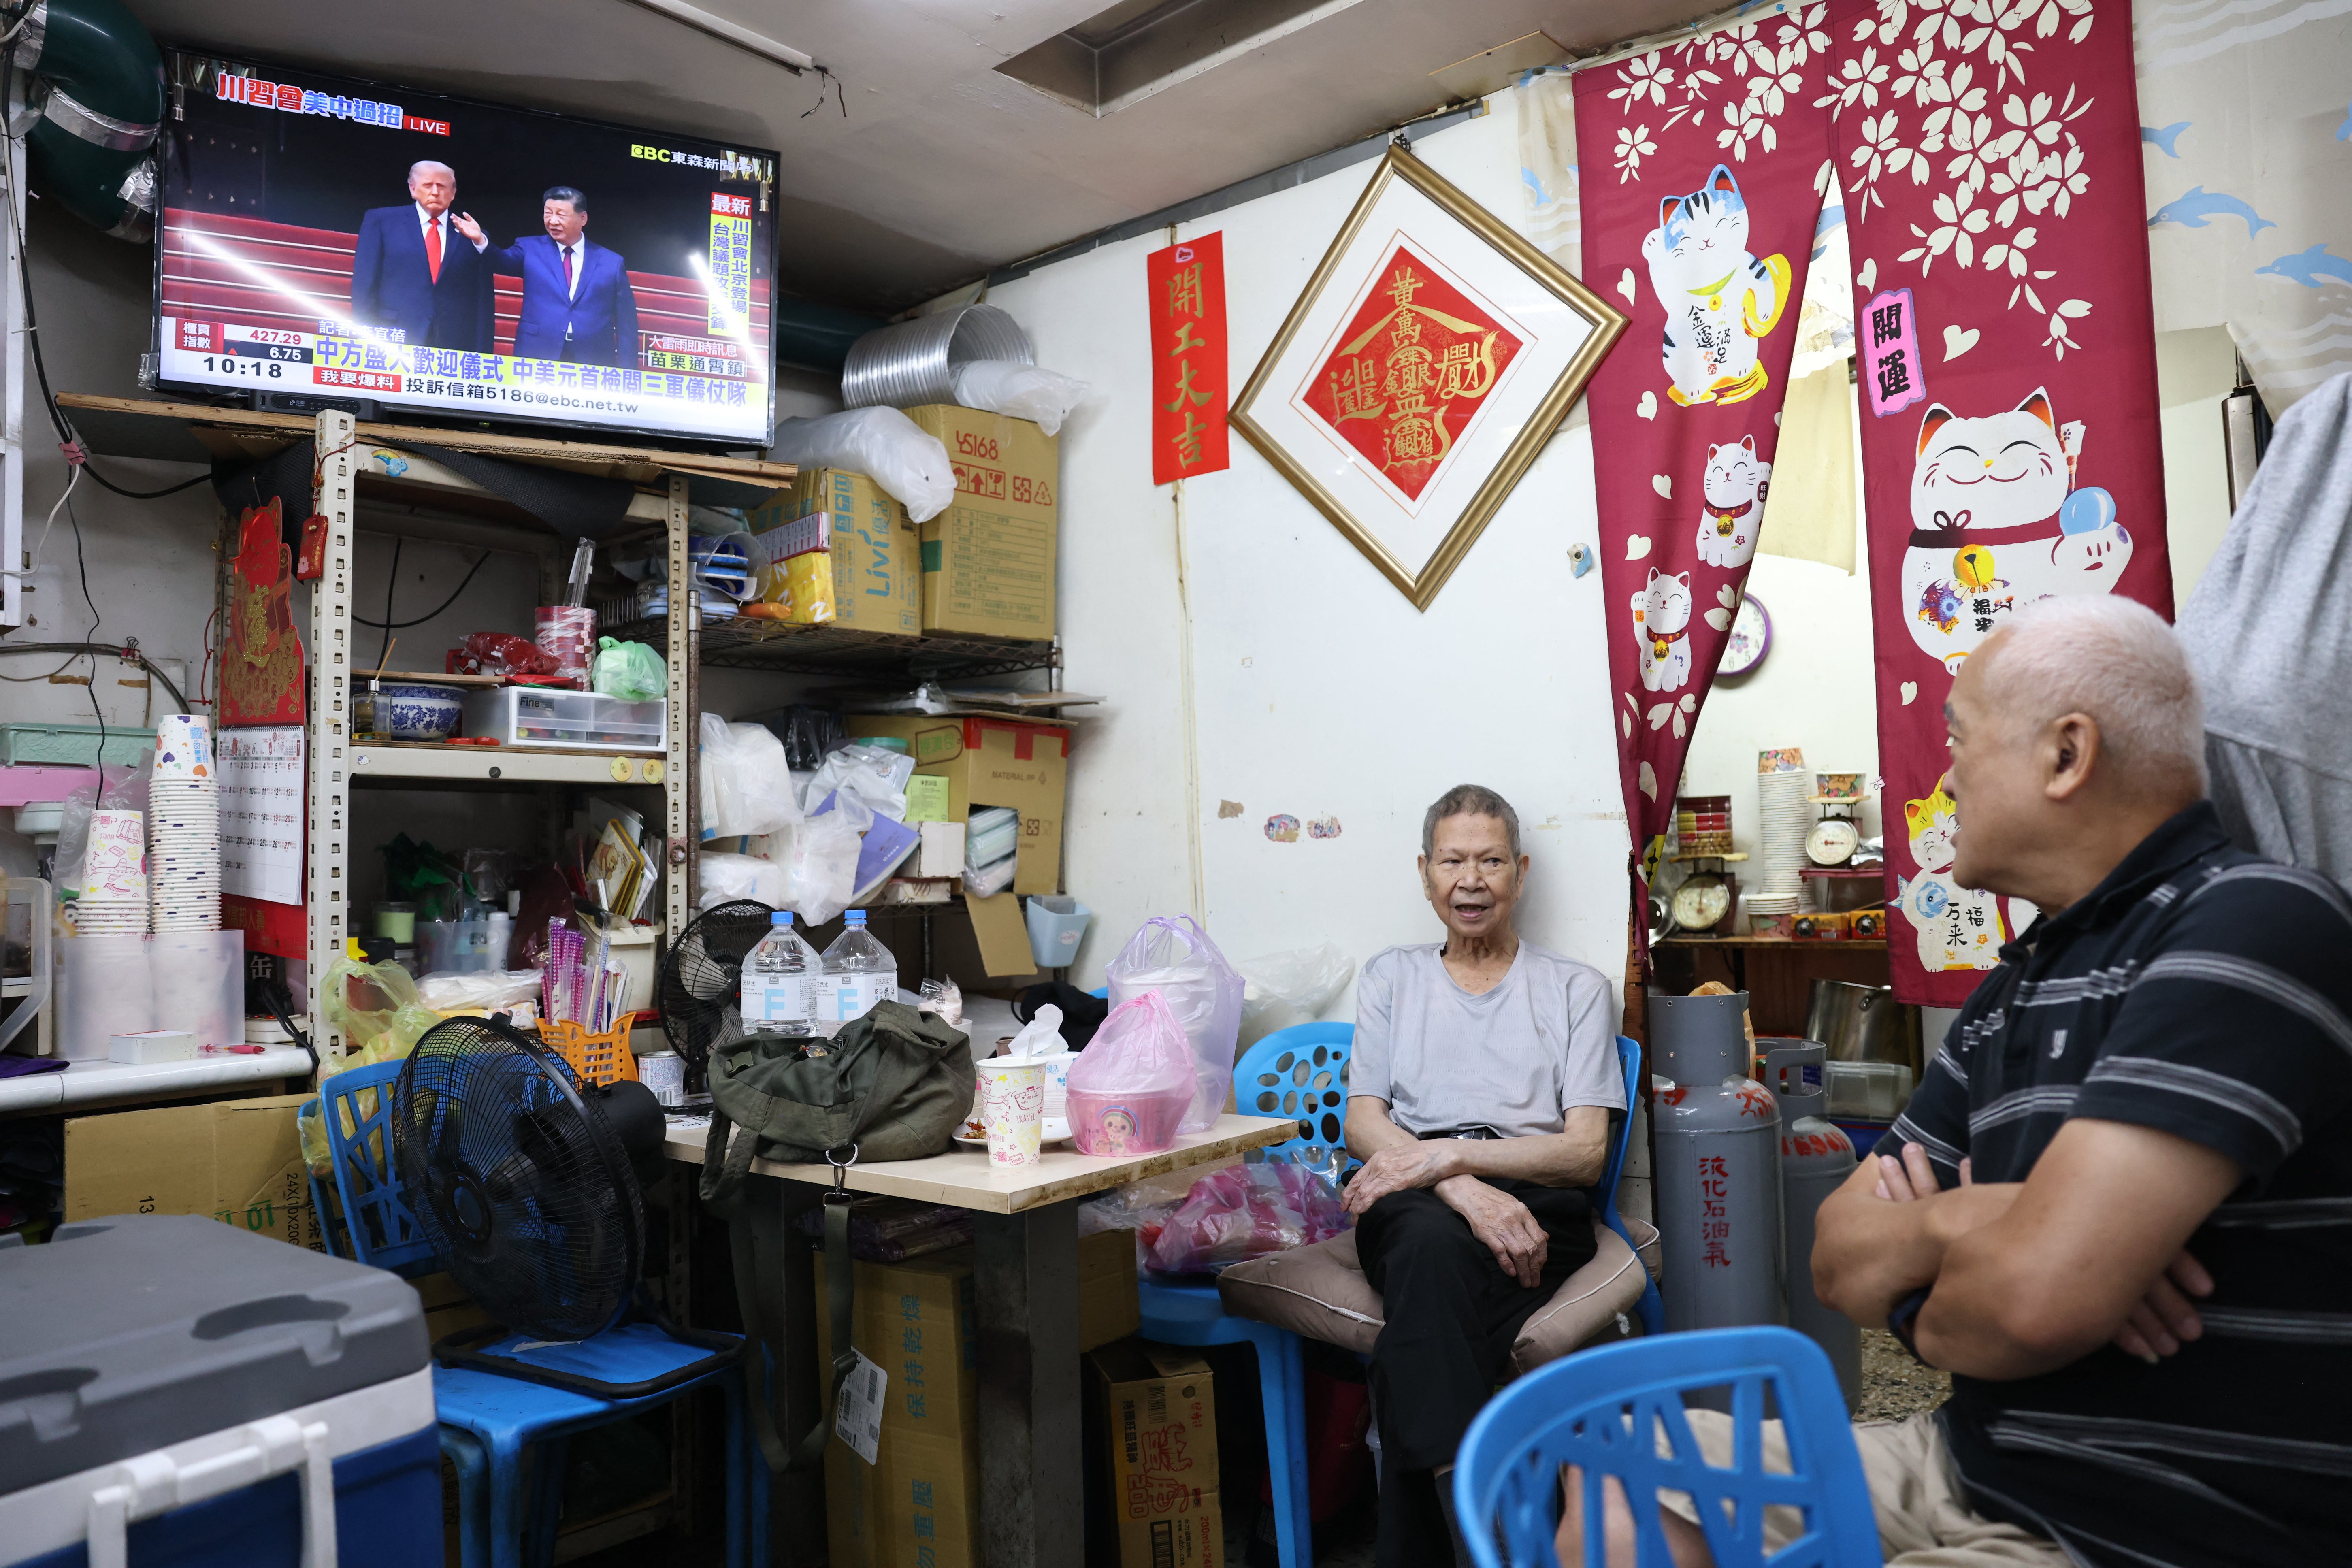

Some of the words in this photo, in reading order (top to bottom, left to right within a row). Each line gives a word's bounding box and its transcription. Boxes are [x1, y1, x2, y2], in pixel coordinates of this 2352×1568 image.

[217, 73, 402, 129] 川習會美中過招
[409, 118, 445, 134] LIVE
[671, 151, 734, 172] 東森新聞
[712, 194, 750, 216] 最新
[731, 219, 749, 313] 川習會北京登場
[183, 322, 210, 336] 櫃買
[250, 329, 301, 345] 427.29
[183, 336, 211, 349] 指數
[649, 335, 737, 357] 大雷雨即時訊息
[1873, 303, 1910, 402] 開運
[269, 347, 301, 360] 6.75
[203, 357, 281, 378] 10:18
[317, 337, 504, 383] 中方盛大歡迎儀式
[513, 358, 746, 407] 中美元首檢閱三軍儀仗隊
[651, 352, 744, 376] 苗栗通霄鎮
[1163, 262, 1213, 470] 開工大吉
[321, 369, 394, 389] 我要爆料
[1760, 484, 1767, 500] 旺財
[871, 499, 892, 536] 優活
[1754, 611, 1760, 621] 2
[1759, 624, 1764, 635] 3
[1755, 639, 1760, 650] 4
[1729, 658, 1734, 668] 6
[1745, 650, 1751, 662] 5
[520, 697, 540, 707] Fine
[250, 955, 273, 979] 缶
[765, 989, 785, 1020] F
[837, 989, 858, 1020] F
[1047, 1064, 1059, 1074] 優活
[1016, 1113, 1035, 1123] TRAVEL
[992, 1134, 1005, 1142] WORLD
[138, 1195, 154, 1214] 13
[1699, 1157, 1731, 1268] 液化石油氣
[901, 1294, 927, 1419] 保持乾燥
[912, 1479, 935, 1568] 勿重壓
